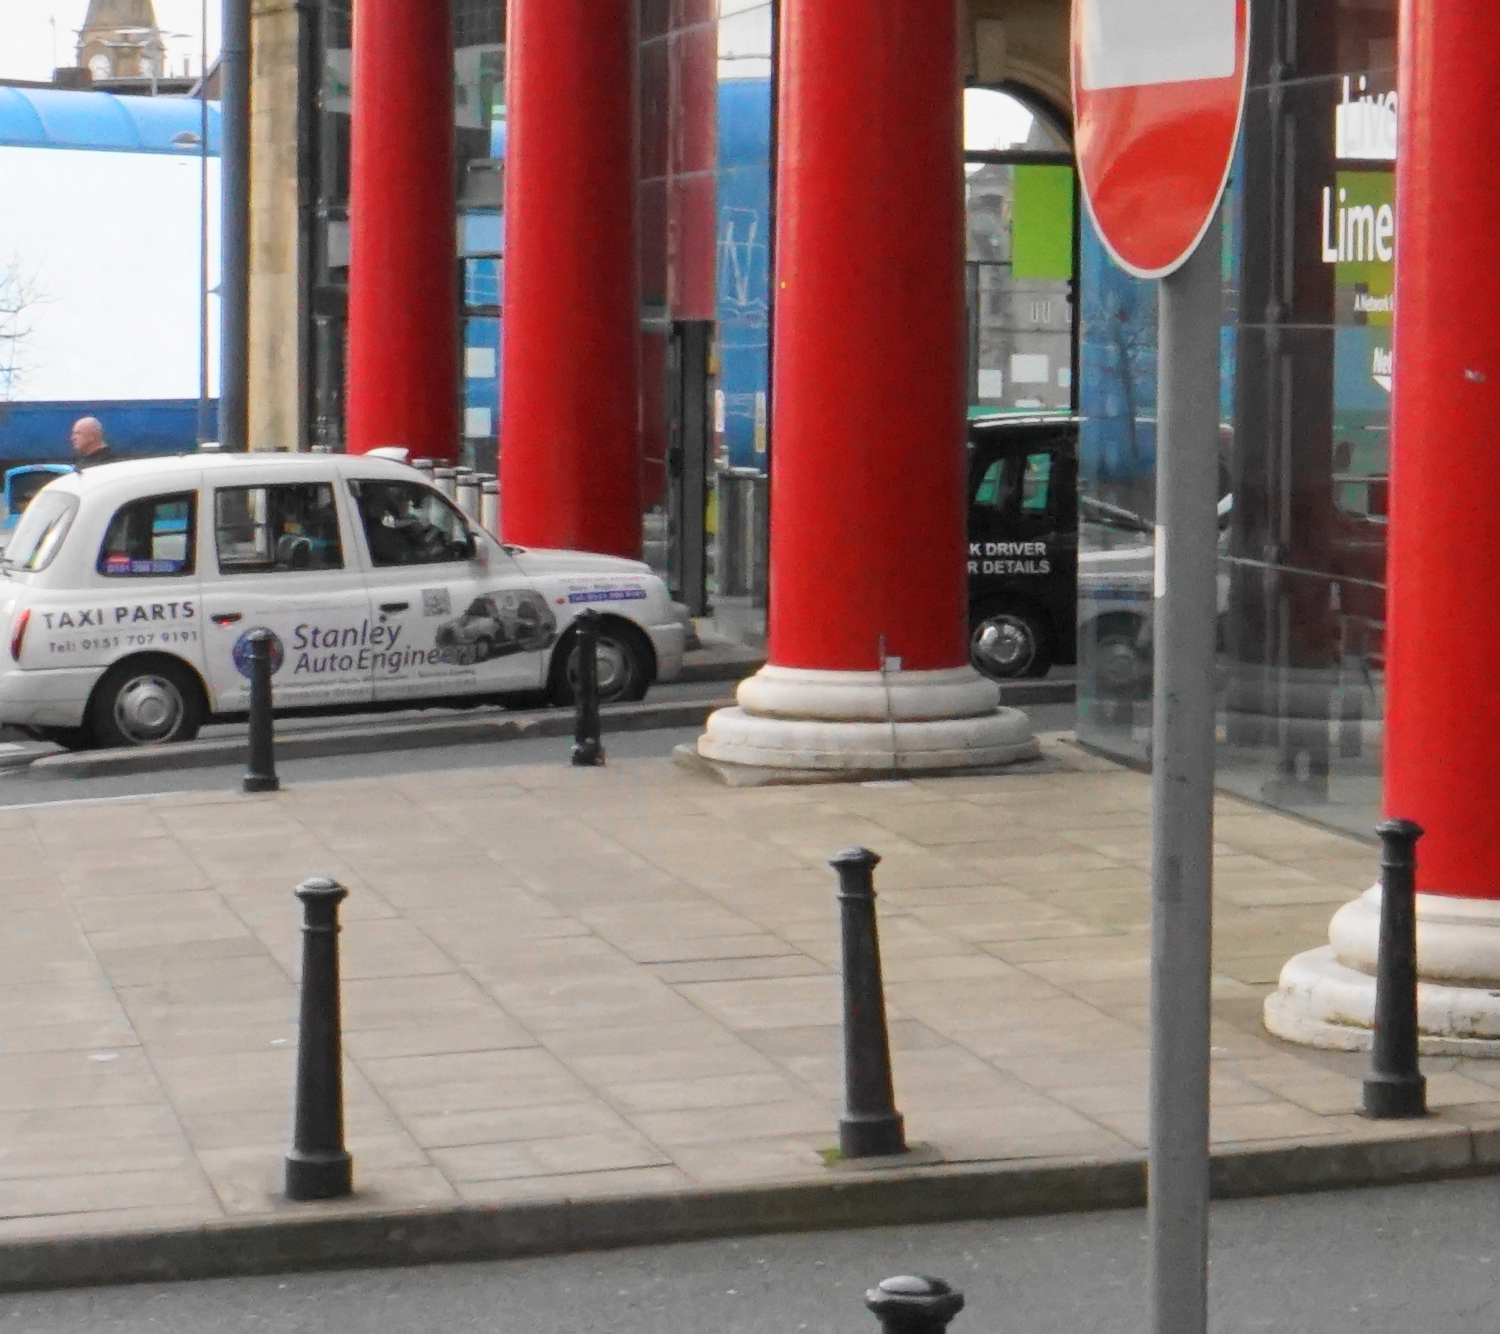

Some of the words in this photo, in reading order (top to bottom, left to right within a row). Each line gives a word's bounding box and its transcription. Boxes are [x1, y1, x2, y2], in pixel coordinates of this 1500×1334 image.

[1321, 185, 1394, 263] Lime
[985, 541, 1047, 556] DRIVER
[982, 559, 1051, 574] DETAILS
[41, 610, 104, 629] TAXI
[115, 601, 195, 623] PARTS
[81, 635, 119, 651] 0151
[127, 633, 155, 646] 707
[161, 630, 198, 643] 9191
[293, 619, 402, 651] Stanley
